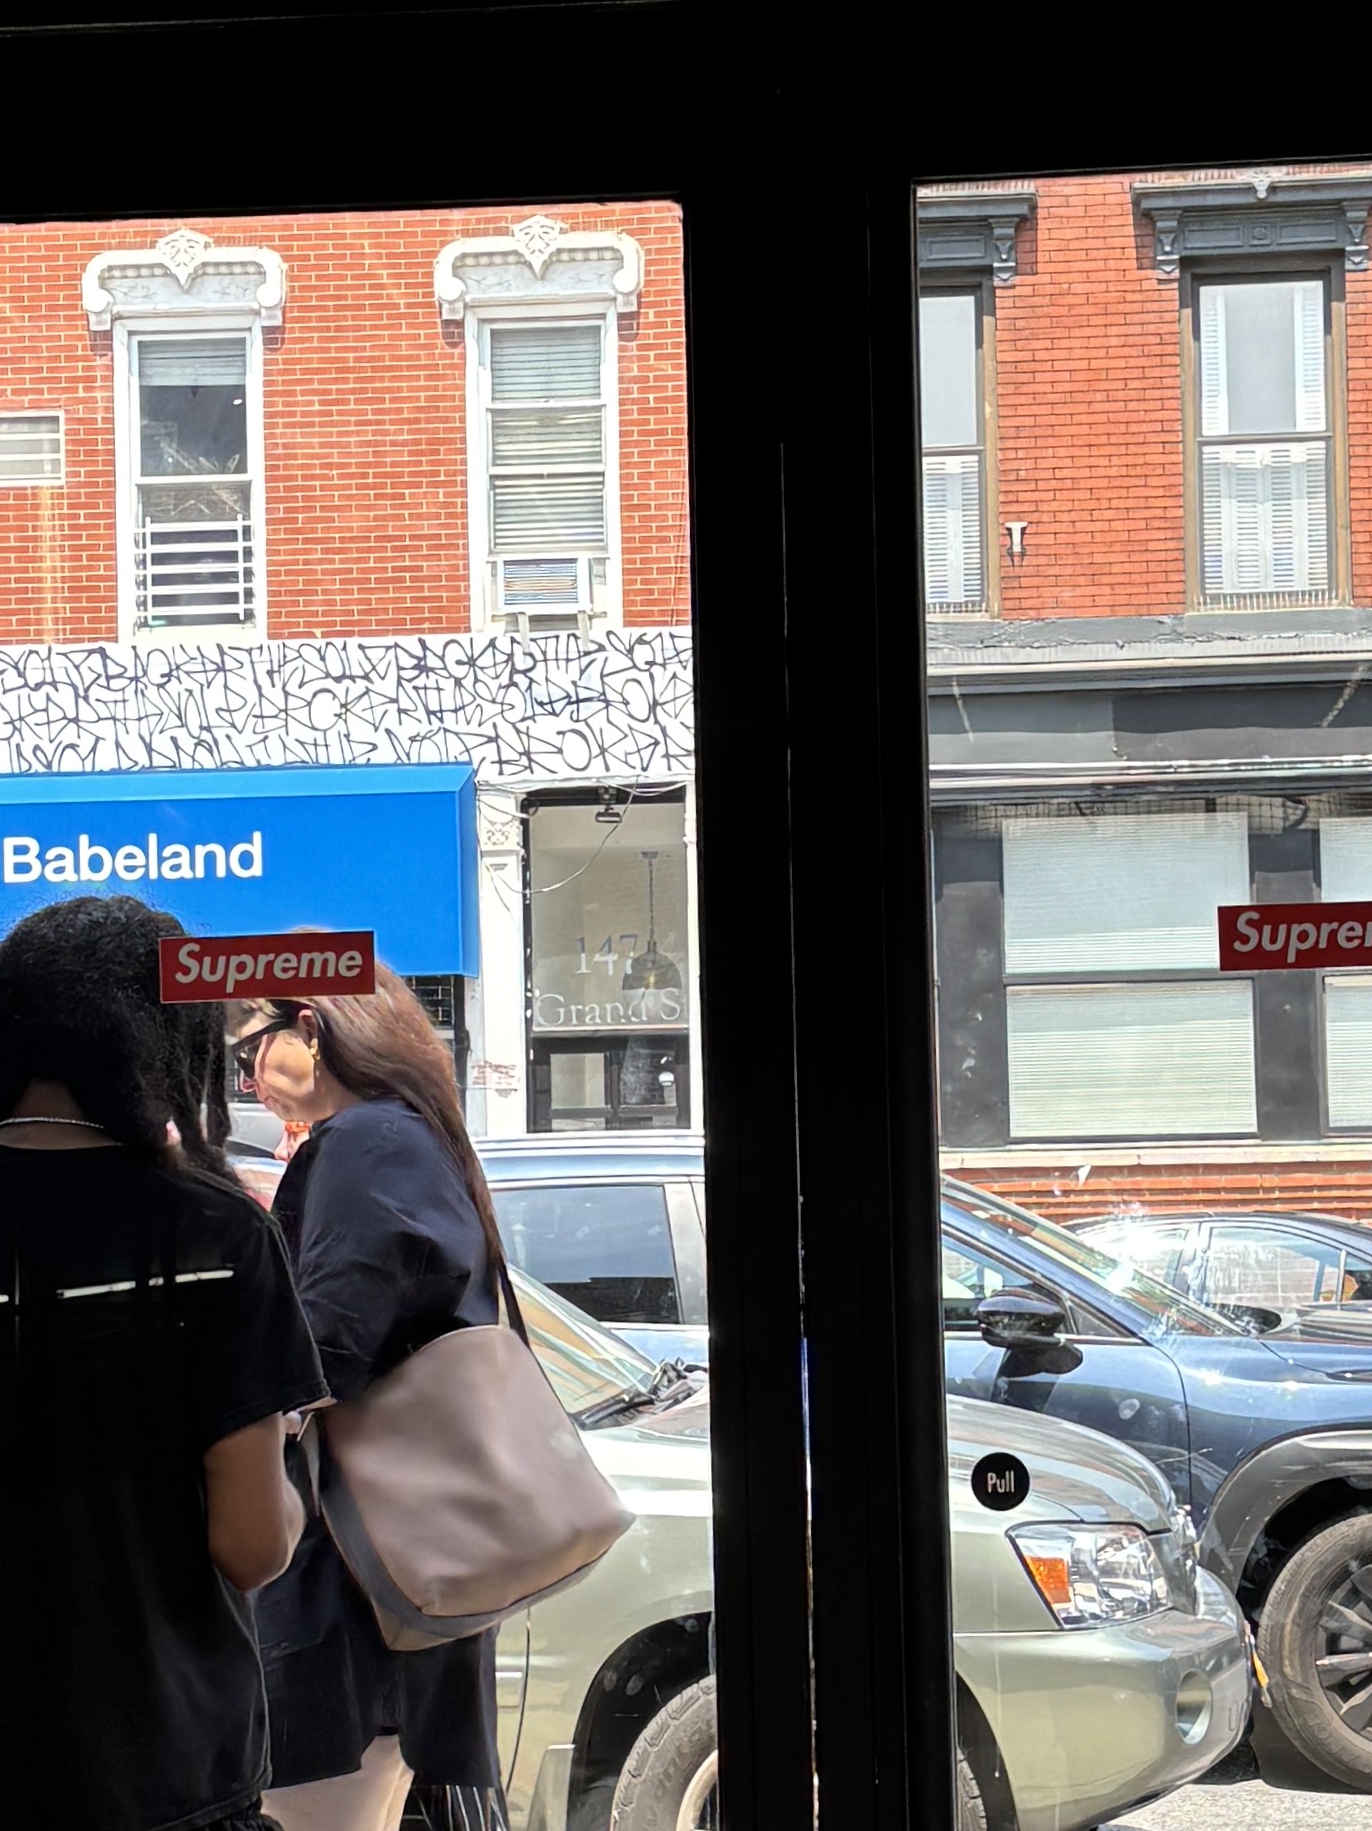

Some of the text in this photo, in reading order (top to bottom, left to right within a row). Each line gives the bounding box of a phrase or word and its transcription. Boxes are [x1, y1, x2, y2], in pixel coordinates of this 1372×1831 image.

[2, 831, 263, 884] Babeland
[175, 942, 363, 994] Supreme
[575, 934, 638, 976] 147
[534, 990, 648, 1027] Grand
[987, 1470, 1015, 1493] Pull
